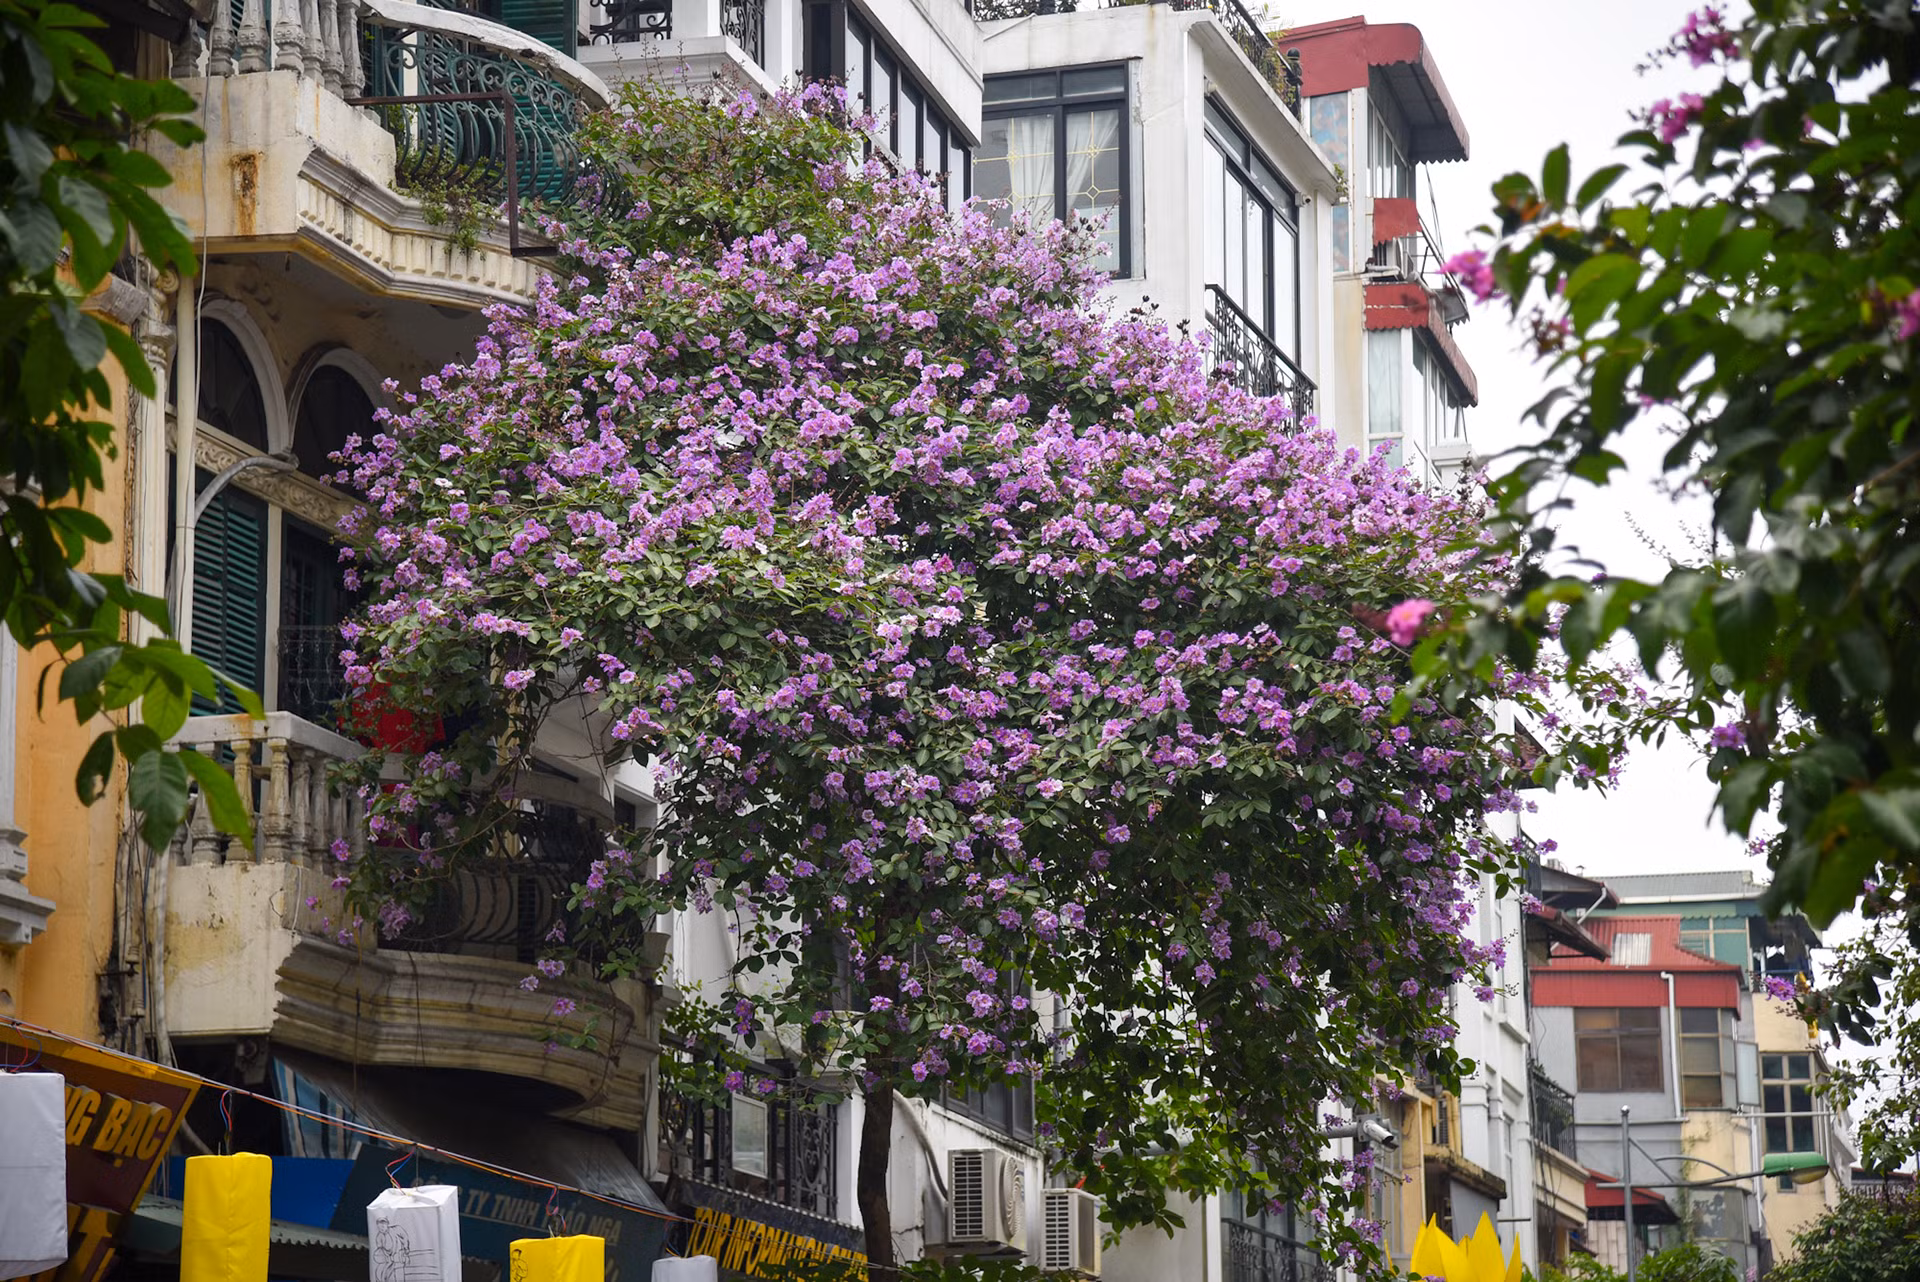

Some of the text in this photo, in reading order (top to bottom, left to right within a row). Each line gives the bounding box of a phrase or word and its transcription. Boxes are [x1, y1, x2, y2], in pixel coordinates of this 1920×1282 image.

[464, 1188, 491, 1215] TY
[491, 1194, 541, 1226] TNHH
[688, 1207, 732, 1265] TOUR
